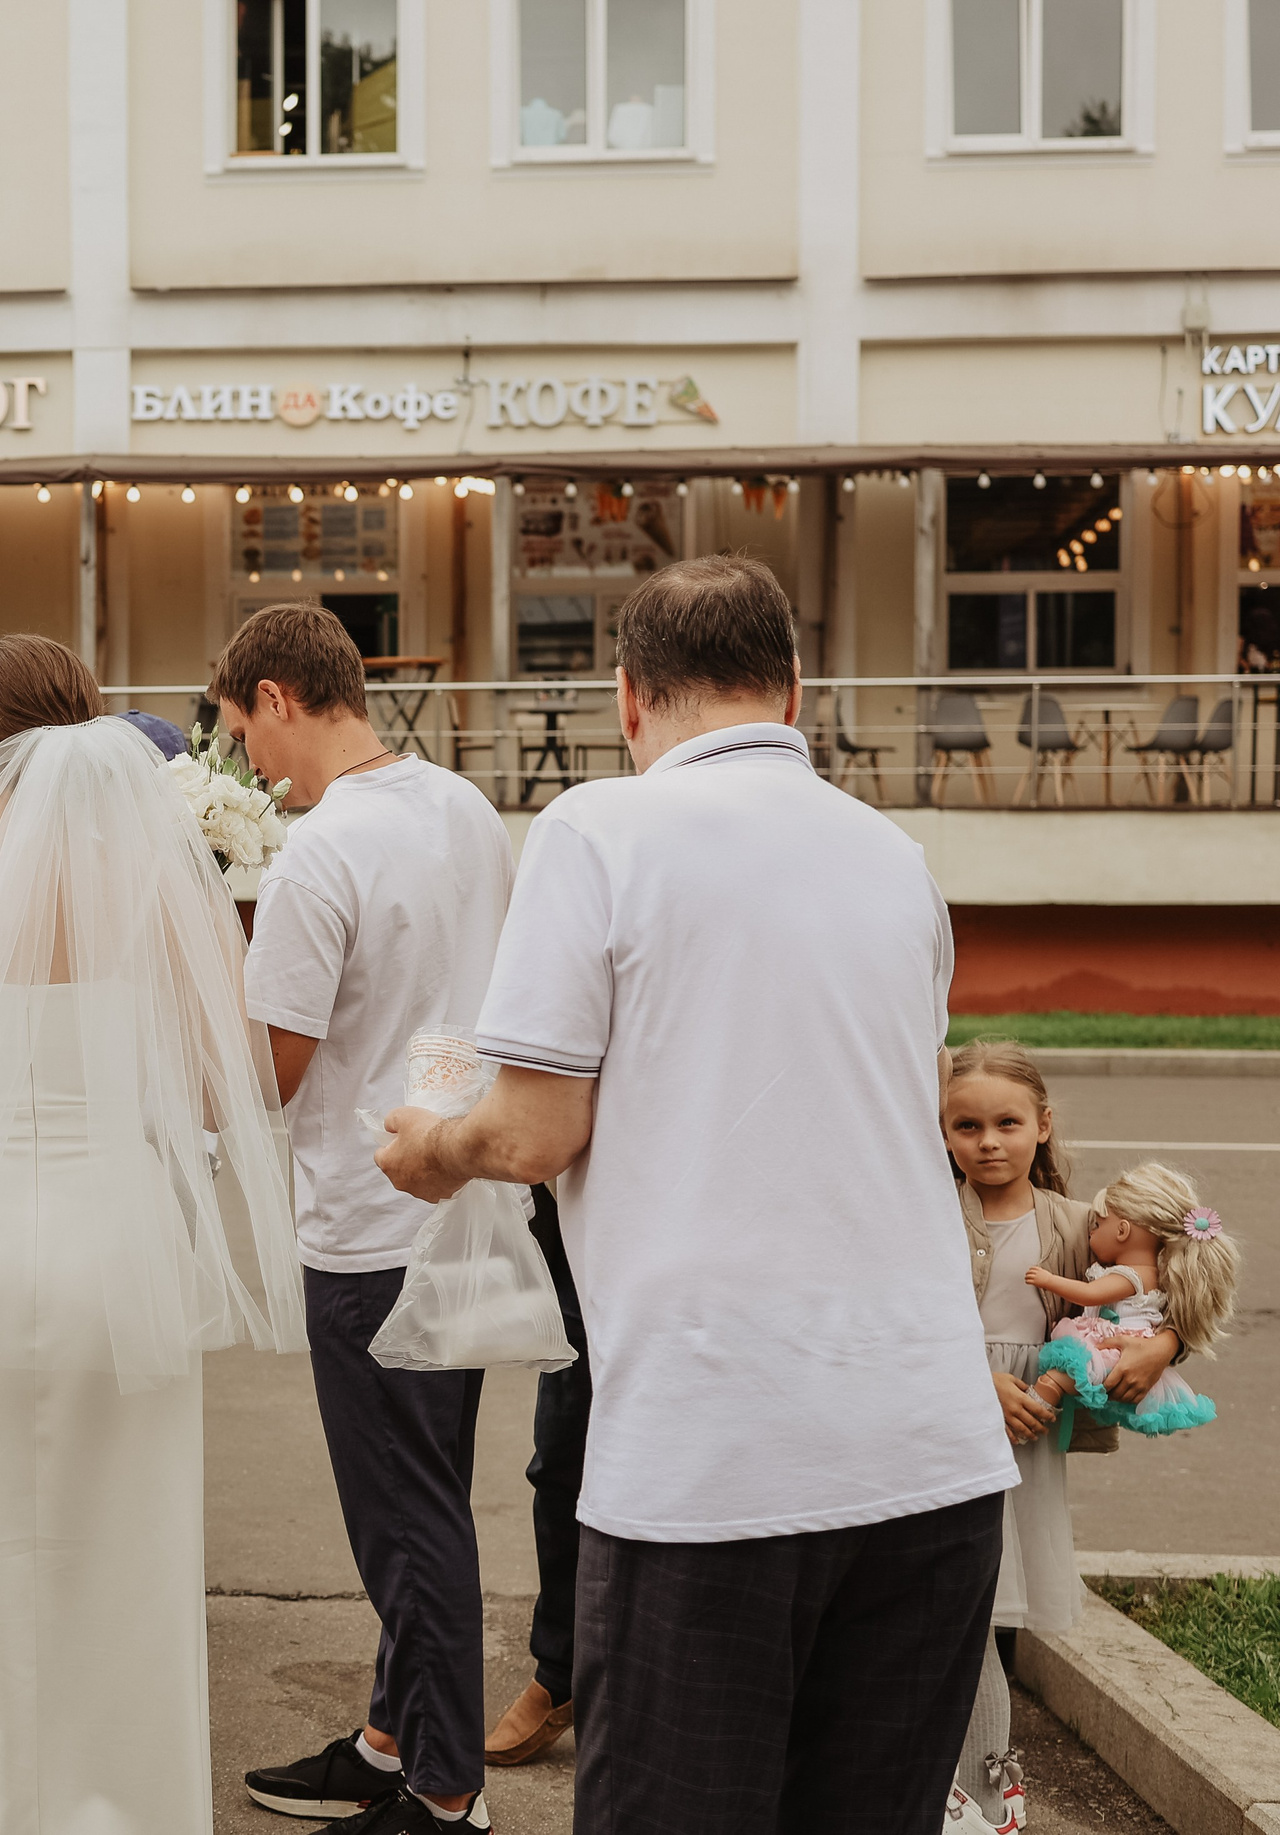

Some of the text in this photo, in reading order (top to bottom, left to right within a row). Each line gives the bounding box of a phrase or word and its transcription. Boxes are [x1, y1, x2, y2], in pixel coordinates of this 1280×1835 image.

[132, 384, 460, 430] БЛИН ДА Кофе
[487, 375, 660, 431] КОФЕ
[1202, 383, 1280, 434] КУ
